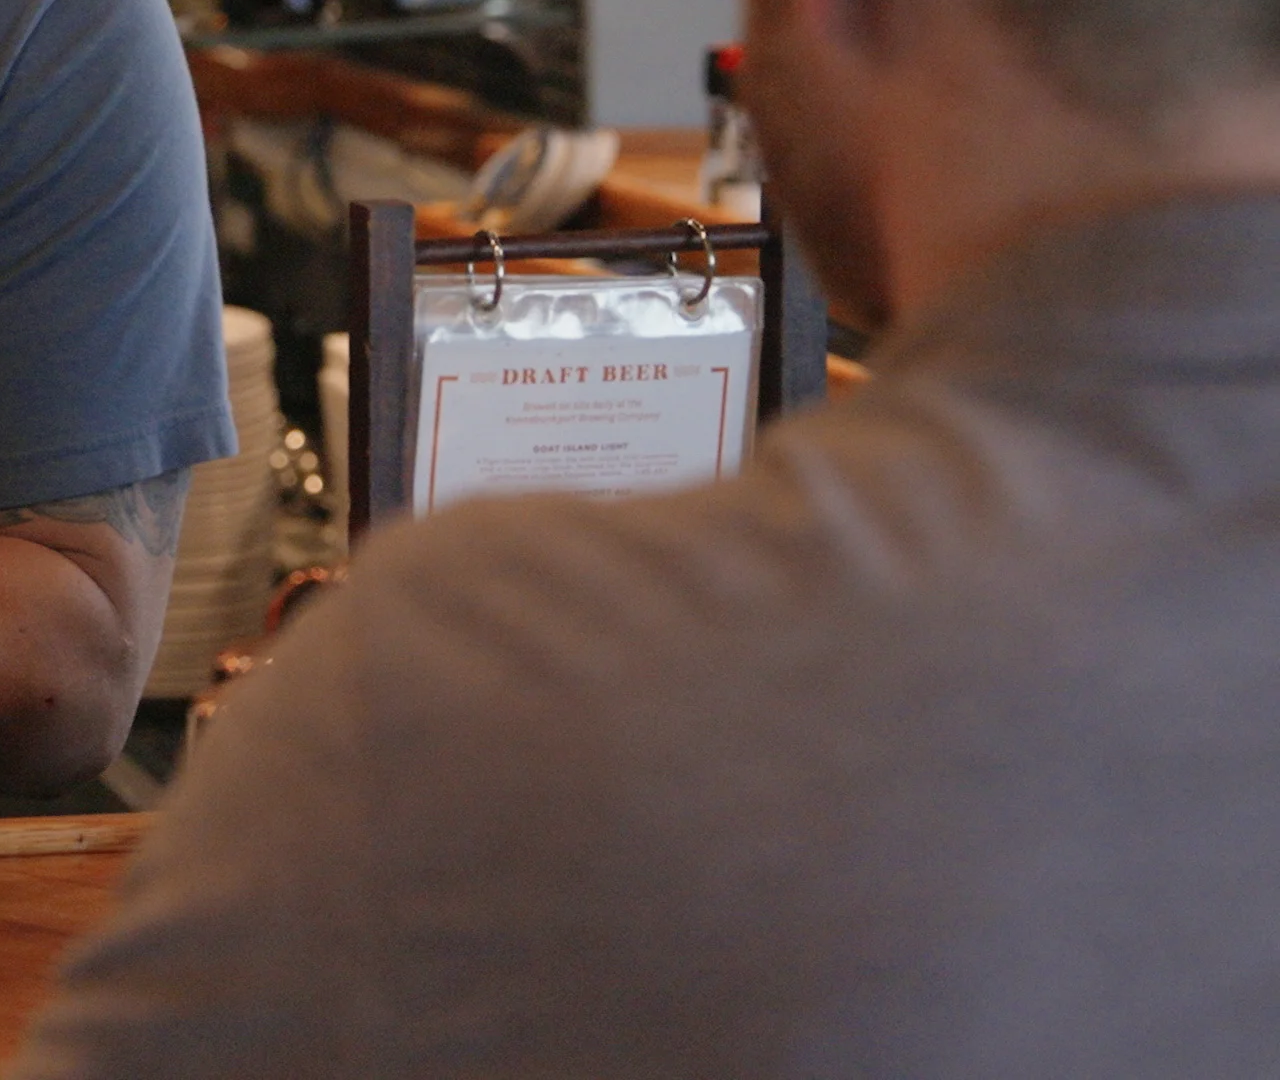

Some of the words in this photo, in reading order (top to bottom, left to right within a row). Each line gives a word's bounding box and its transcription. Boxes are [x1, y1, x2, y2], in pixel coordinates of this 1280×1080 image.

[502, 365, 589, 386] DRAFT
[602, 363, 668, 382] BEER
[532, 444, 560, 454] GOAT
[563, 443, 598, 453] ISLAND
